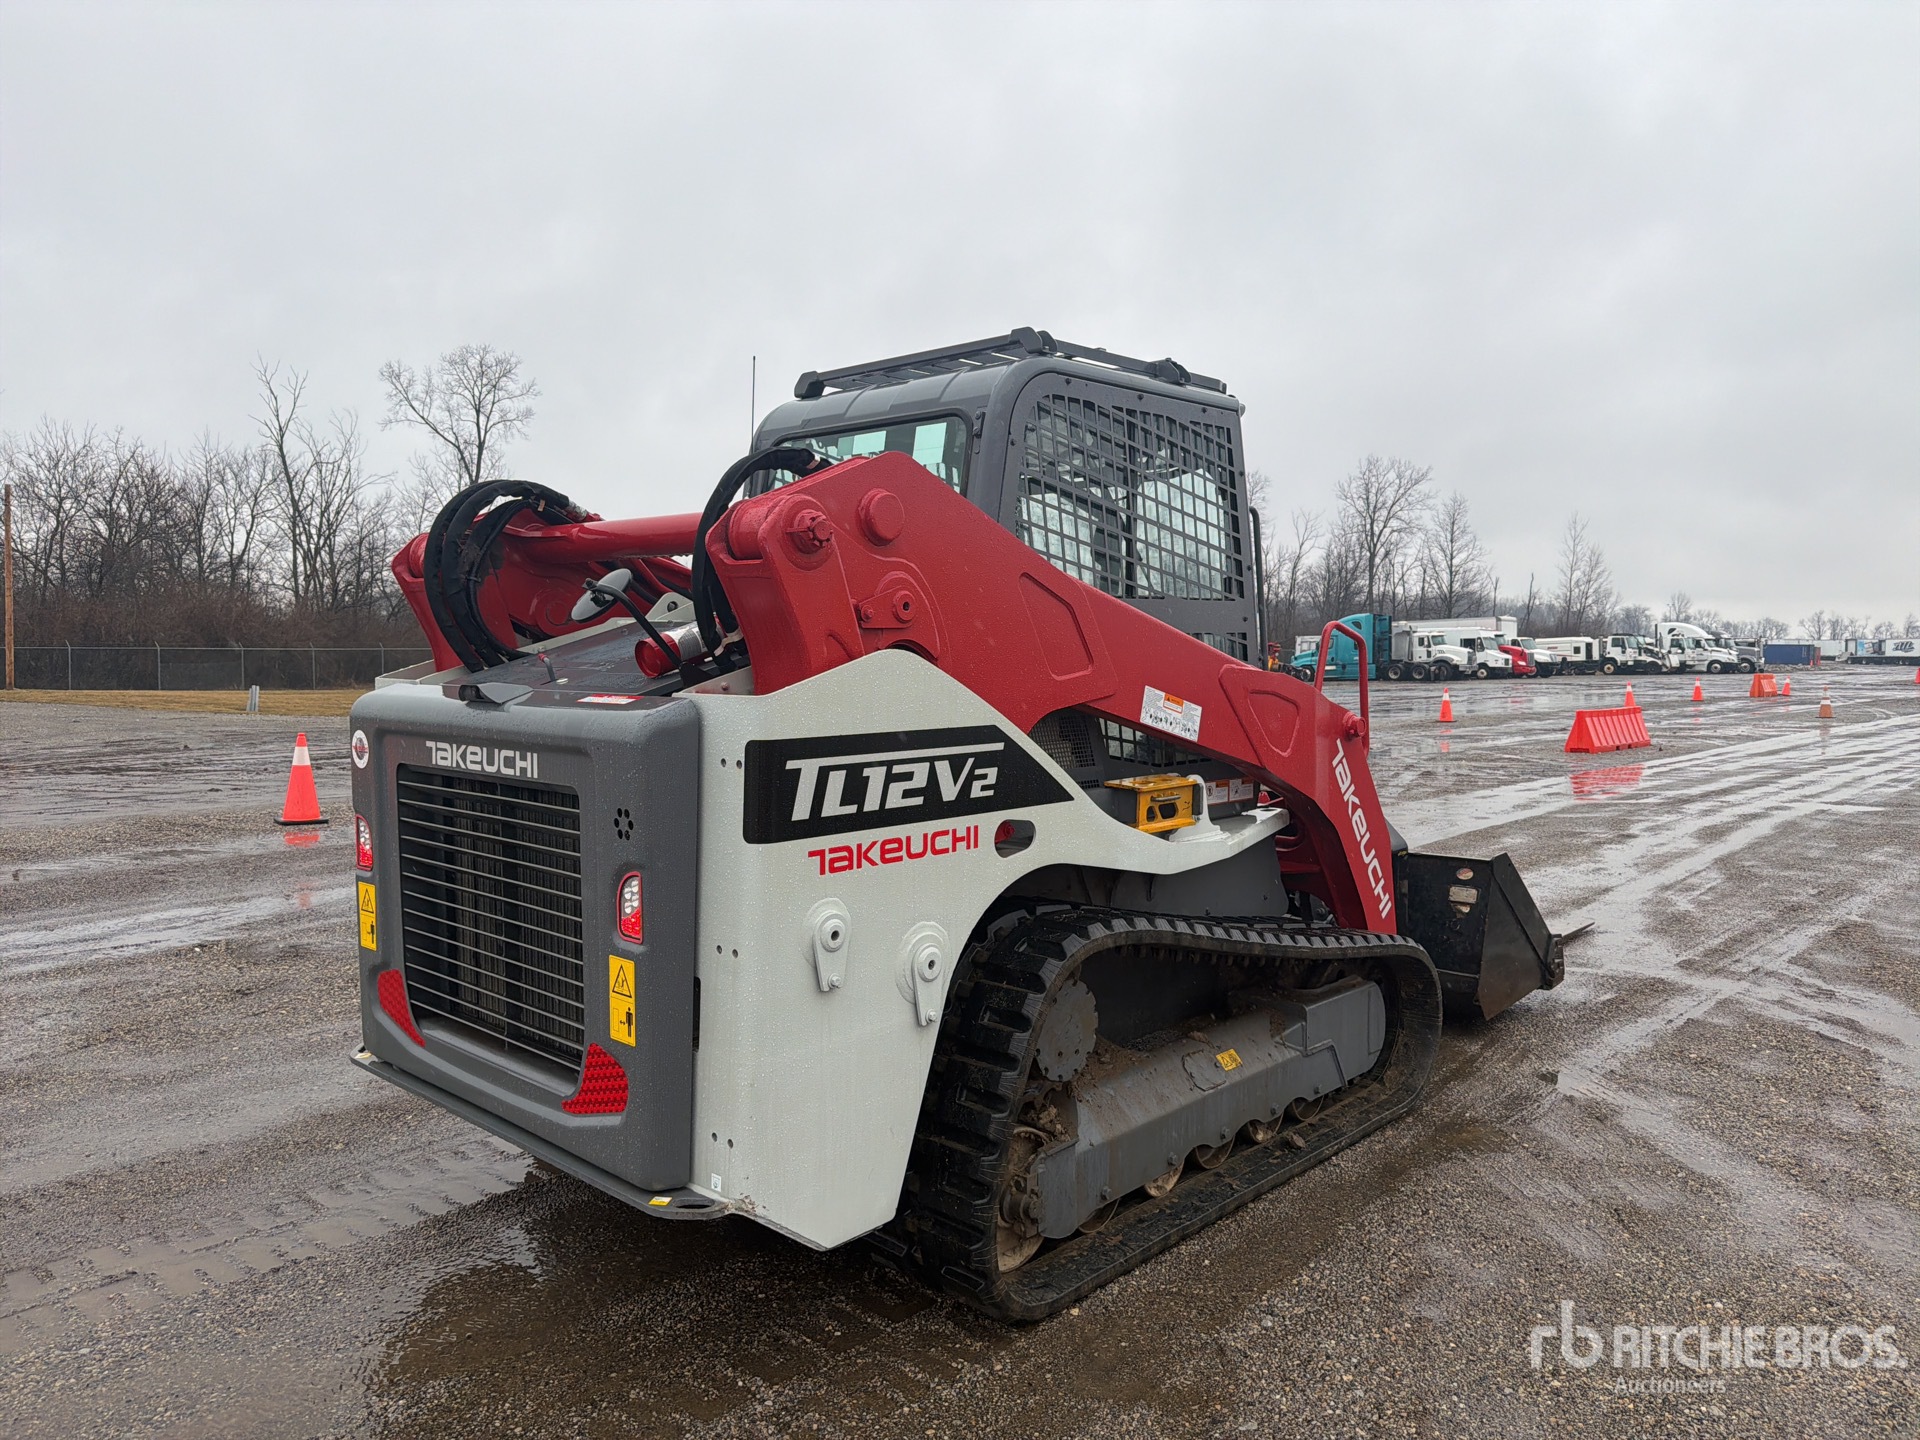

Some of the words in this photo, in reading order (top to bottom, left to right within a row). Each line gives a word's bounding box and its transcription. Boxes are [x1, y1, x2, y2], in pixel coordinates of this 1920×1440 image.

[426, 740, 539, 779] TAKEUCHI
[807, 824, 979, 876] TAKEUCHI
[1331, 738, 1393, 920] TAKEUCHI
